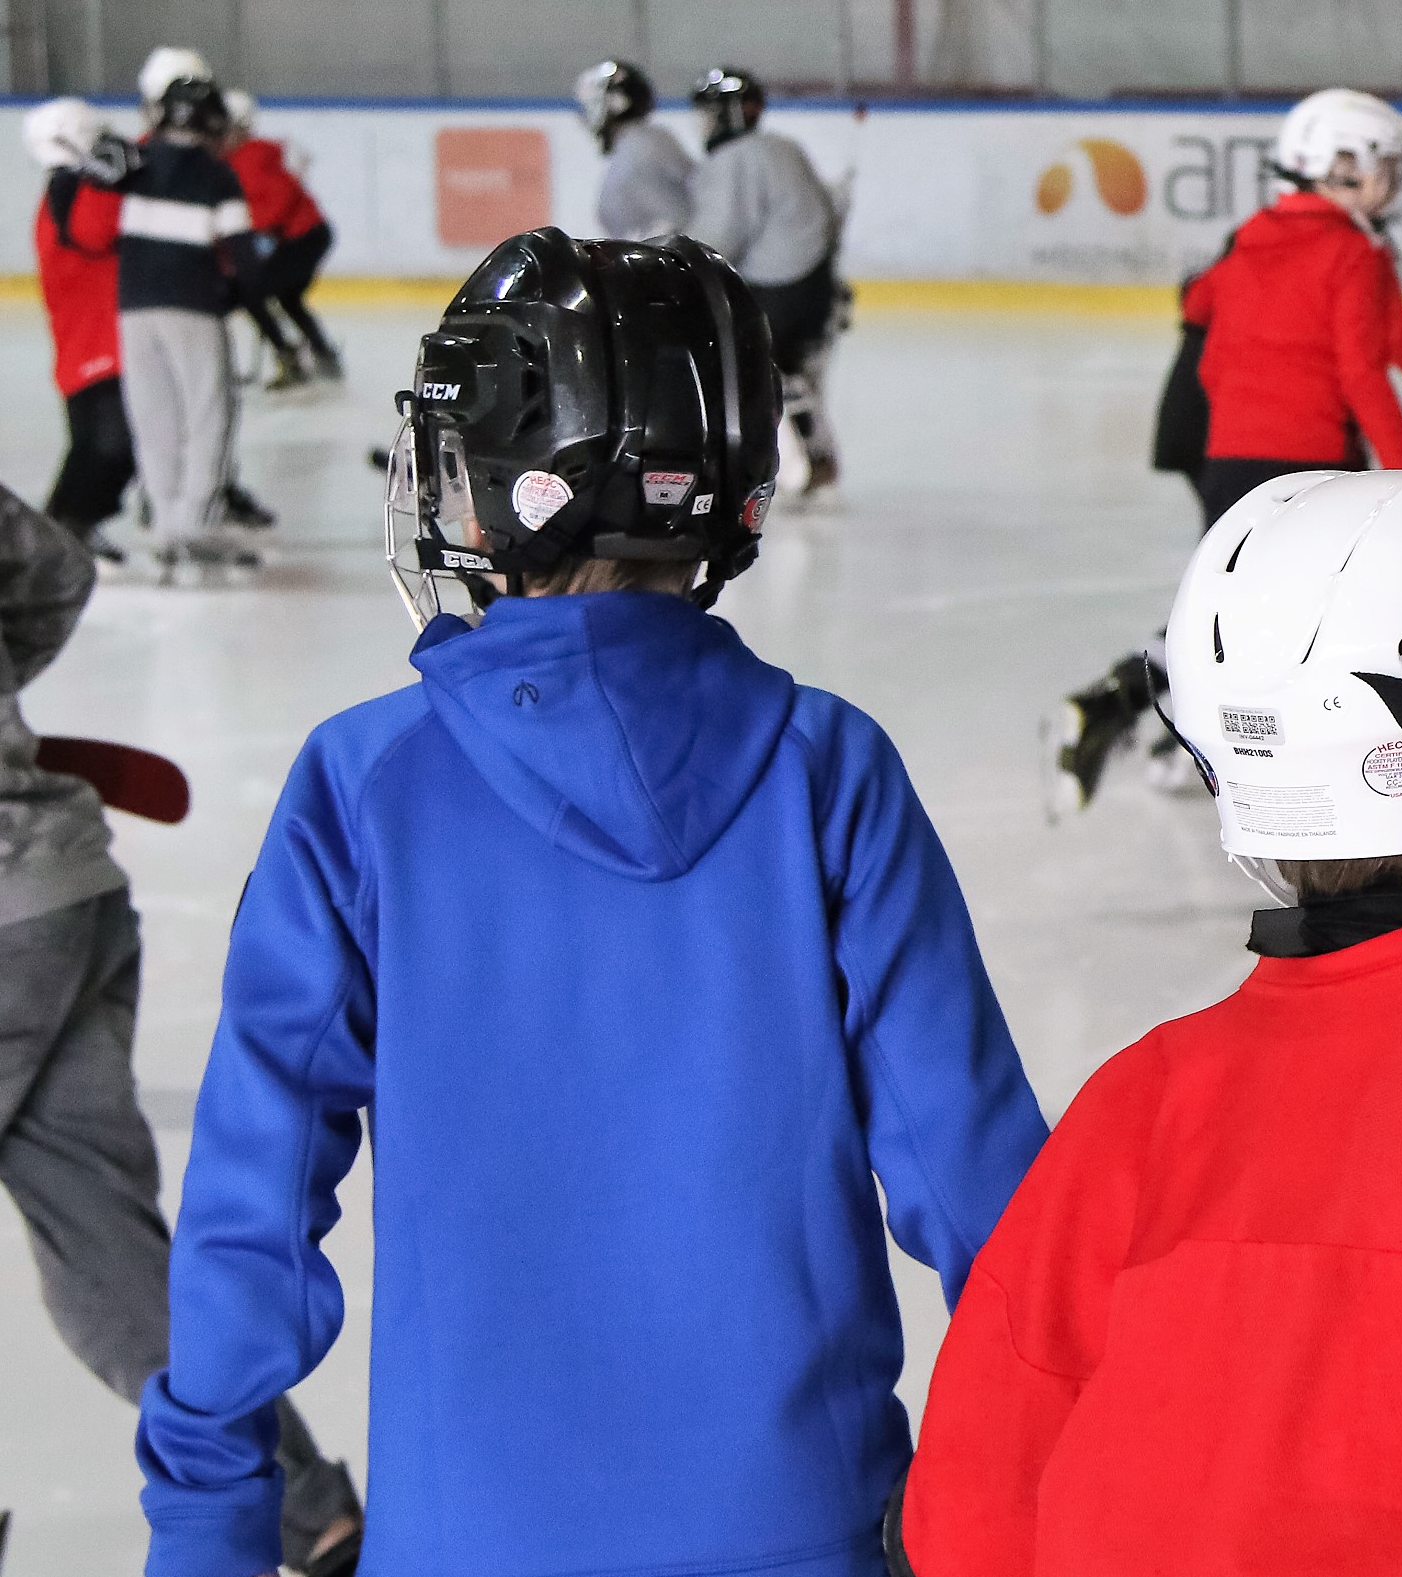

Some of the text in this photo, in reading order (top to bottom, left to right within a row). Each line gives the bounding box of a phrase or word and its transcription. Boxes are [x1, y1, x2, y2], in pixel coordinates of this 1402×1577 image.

[422, 382, 461, 400] CCM
[648, 473, 687, 482] CCM
[440, 549, 494, 570] CCM
